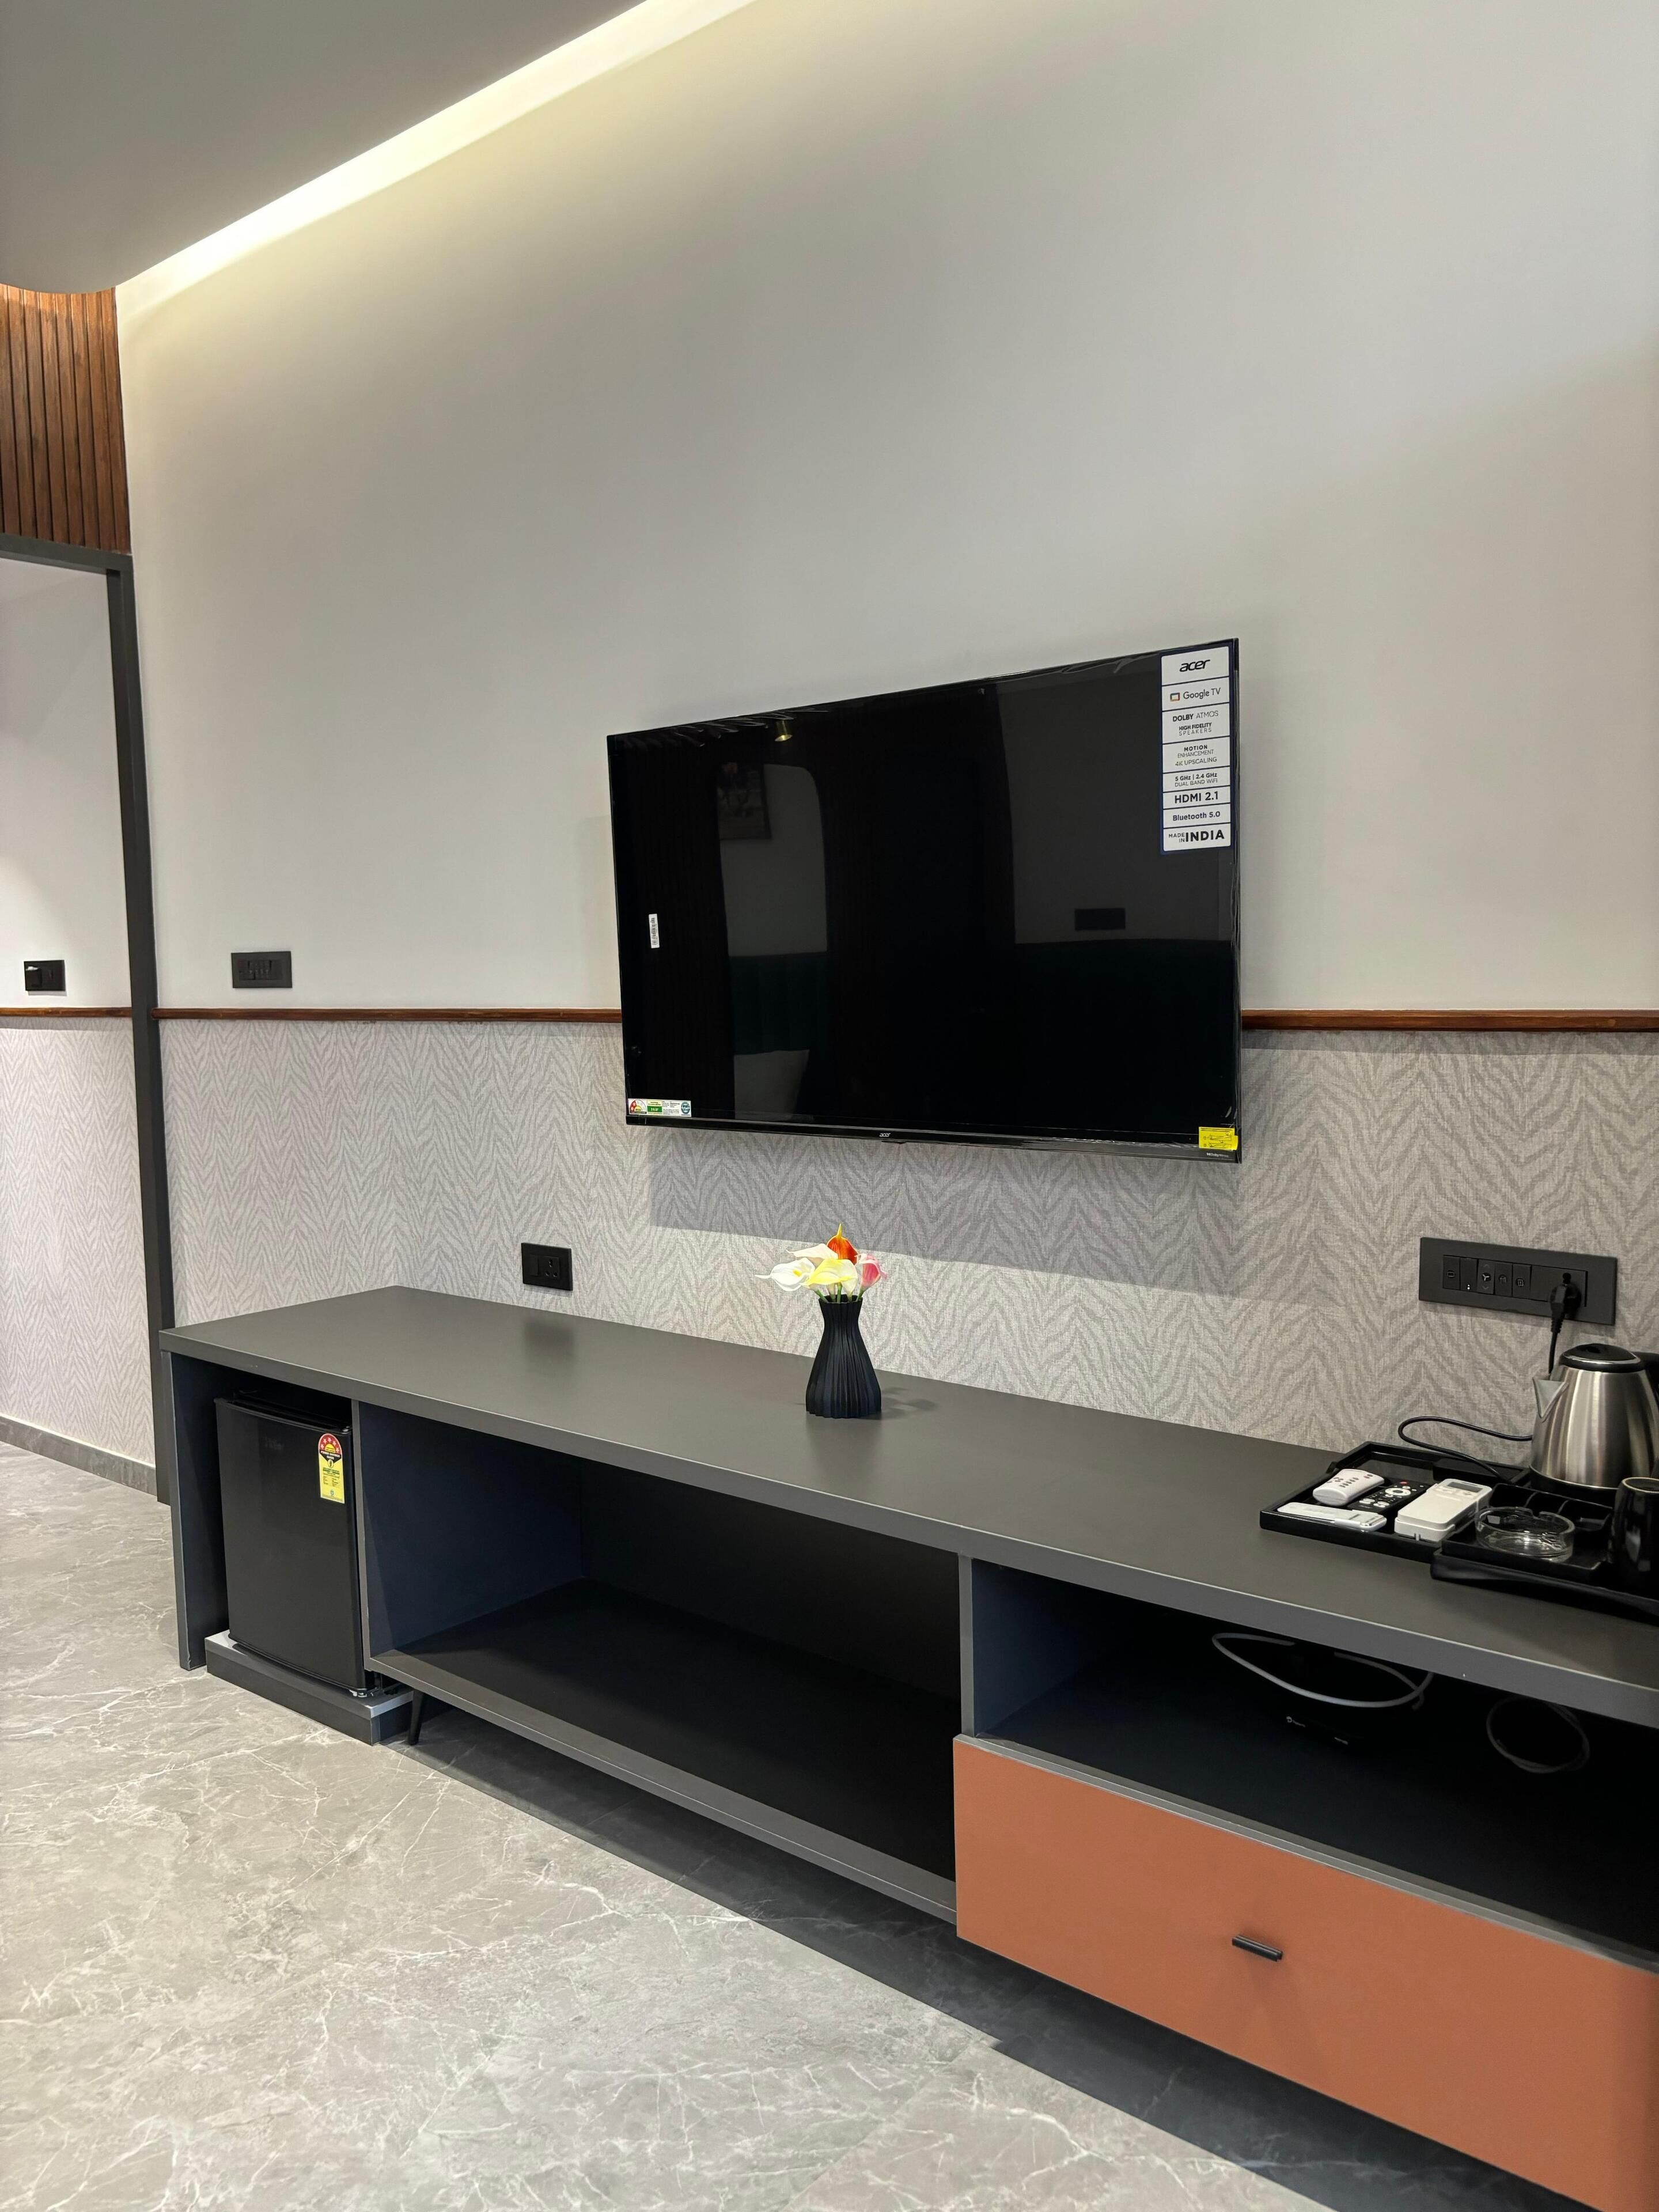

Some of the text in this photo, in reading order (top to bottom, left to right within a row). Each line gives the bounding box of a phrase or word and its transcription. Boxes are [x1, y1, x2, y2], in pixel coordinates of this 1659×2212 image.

[1179, 660, 1210, 672] acer
[1183, 688, 1221, 699] Google TV
[1173, 711, 1218, 722] DOLBY ATMOS
[1177, 750, 1214, 758] ENHANCEMENT
[1184, 757, 1217, 766] UPSCALING
[1175, 791, 1218, 804] HDMI 2.1
[1173, 812, 1207, 821] Bluetooth
[1185, 830, 1225, 842] INDIA
